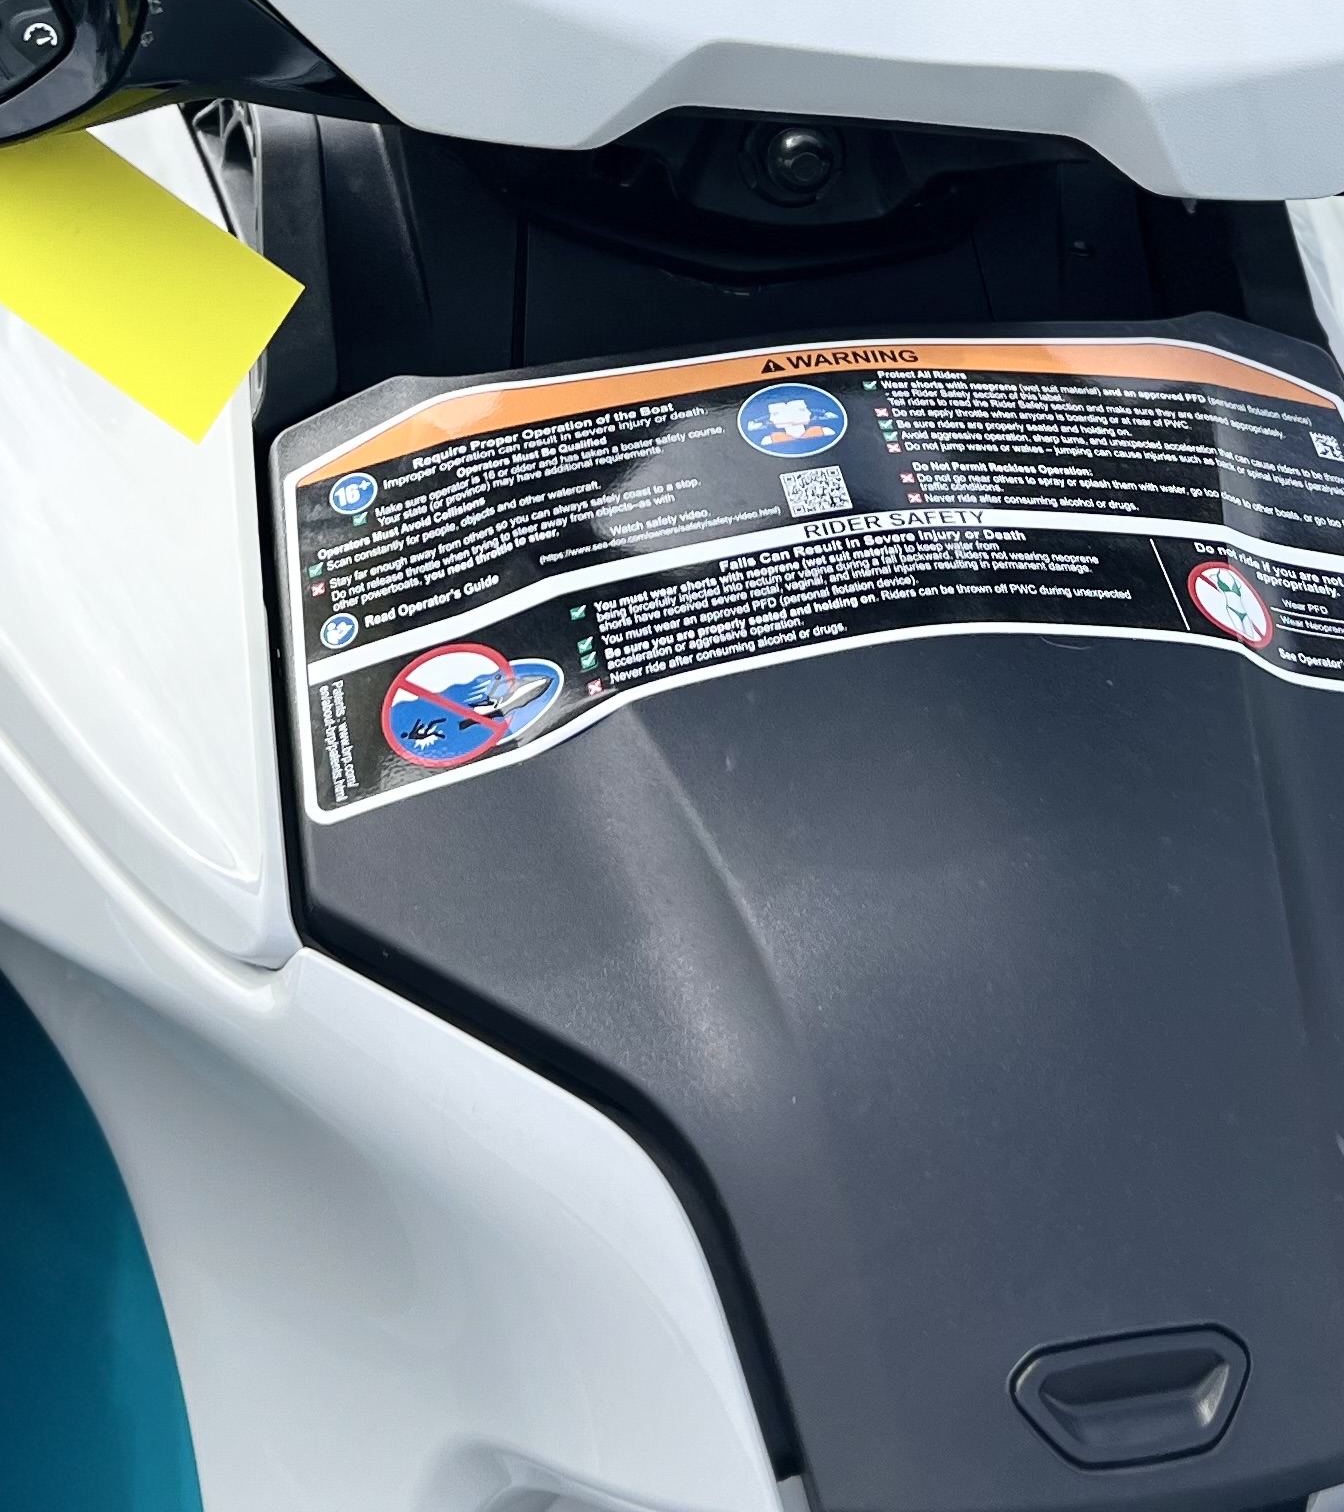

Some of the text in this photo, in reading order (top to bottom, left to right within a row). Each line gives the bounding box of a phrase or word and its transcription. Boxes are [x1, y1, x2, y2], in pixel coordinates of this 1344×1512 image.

[786, 349, 919, 369] WARNING
[876, 370, 966, 379] Protect All Riders
[382, 464, 436, 489] Improper
[438, 448, 495, 471] operation
[497, 441, 520, 454] can
[523, 433, 557, 448] result
[574, 423, 615, 438] severe
[618, 416, 651, 431] injury
[653, 413, 667, 424] or
[412, 400, 674, 468] Require Proper Operation of the Boat
[456, 434, 607, 478] Operators Must Be Qualified
[911, 461, 929, 471] Do
[929, 461, 950, 471] Not
[951, 461, 987, 472] Permit
[987, 462, 1036, 474] Reckless
[334, 478, 371, 507] 16+
[920, 482, 949, 491] traffic
[925, 493, 955, 503] Never
[957, 494, 976, 503] ride
[979, 494, 1002, 503] after
[1003, 496, 1058, 508] consuming
[1059, 497, 1094, 507] alcohol
[1095, 500, 1106, 508] or
[317, 498, 486, 560] Operators Must Avoid Collisions
[326, 556, 352, 571] Scan
[353, 538, 404, 562] constantly
[405, 534, 420, 546] for
[460, 508, 495, 527] objects
[496, 498, 516, 514] and
[518, 493, 545, 507] other
[329, 575, 352, 589] Stay
[353, 570, 367, 582] far
[369, 555, 407, 577] enough
[409, 547, 436, 564] away
[437, 539, 461, 554] from
[462, 526, 494, 545] others
[495, 520, 508, 532] so
[508, 514, 529, 530] you
[530, 508, 550, 521] can
[552, 500, 588, 515] always
[590, 491, 621, 507] safely
[622, 484, 651, 500] coast
[652, 483, 664, 493] to
[665, 481, 674, 491] a
[609, 519, 644, 535] Watch
[645, 514, 677, 528] safety
[804, 510, 984, 538] RIDER SAFETY
[718, 556, 756, 572] Falls
[759, 551, 790, 565] Can
[792, 539, 842, 559] Result
[863, 531, 916, 546] Severe
[918, 528, 960, 543] Injury
[964, 530, 980, 540] or
[982, 528, 1027, 540] Death
[1193, 542, 1214, 554] Do
[1217, 547, 1236, 558] not
[1238, 552, 1260, 568] ride
[1261, 559, 1271, 571] if
[1273, 565, 1296, 577] you
[1298, 570, 1319, 582] are
[1321, 575, 1344, 587] not
[593, 539, 999, 612] You must wear shorts with neoprene (wet suit material) to keep water from
[1256, 572, 1340, 597] appropriately.
[364, 606, 396, 627] Read
[463, 574, 500, 594] Guide
[600, 632, 623, 645] You
[624, 624, 652, 639] must
[653, 619, 680, 633] wear
[682, 616, 697, 626] an
[699, 601, 750, 624] approved
[751, 596, 776, 610] PFD
[779, 585, 830, 607] (personal
[831, 580, 874, 595] flotation
[604, 647, 621, 659] Be
[623, 640, 649, 654] sure
[650, 634, 674, 650] you
[676, 629, 695, 641] are
[697, 617, 745, 638] properly
[748, 608, 787, 626] seated
[789, 603, 812, 617] and
[812, 596, 858, 612] holding
[880, 587, 916, 600] Riders
[918, 586, 938, 595] can
[939, 583, 954, 594] be
[955, 582, 992, 593] thrown
[993, 583, 1008, 593] off
[1008, 583, 1037, 594] PWC
[1038, 584, 1072, 599] during
[1073, 588, 1132, 600] unexpected
[1279, 615, 1303, 627] Wear
[1281, 598, 1328, 614] Wear PFD
[607, 646, 672, 670] acceleration
[674, 642, 686, 653] or
[688, 628, 747, 650] aggressive
[609, 667, 642, 684] Never
[645, 660, 666, 675] ride
[668, 654, 693, 669] after
[695, 640, 755, 662] consuming
[757, 629, 796, 648] alcohol
[798, 628, 810, 639] or
[1278, 647, 1296, 660] See
[332, 679, 346, 717] Patents
